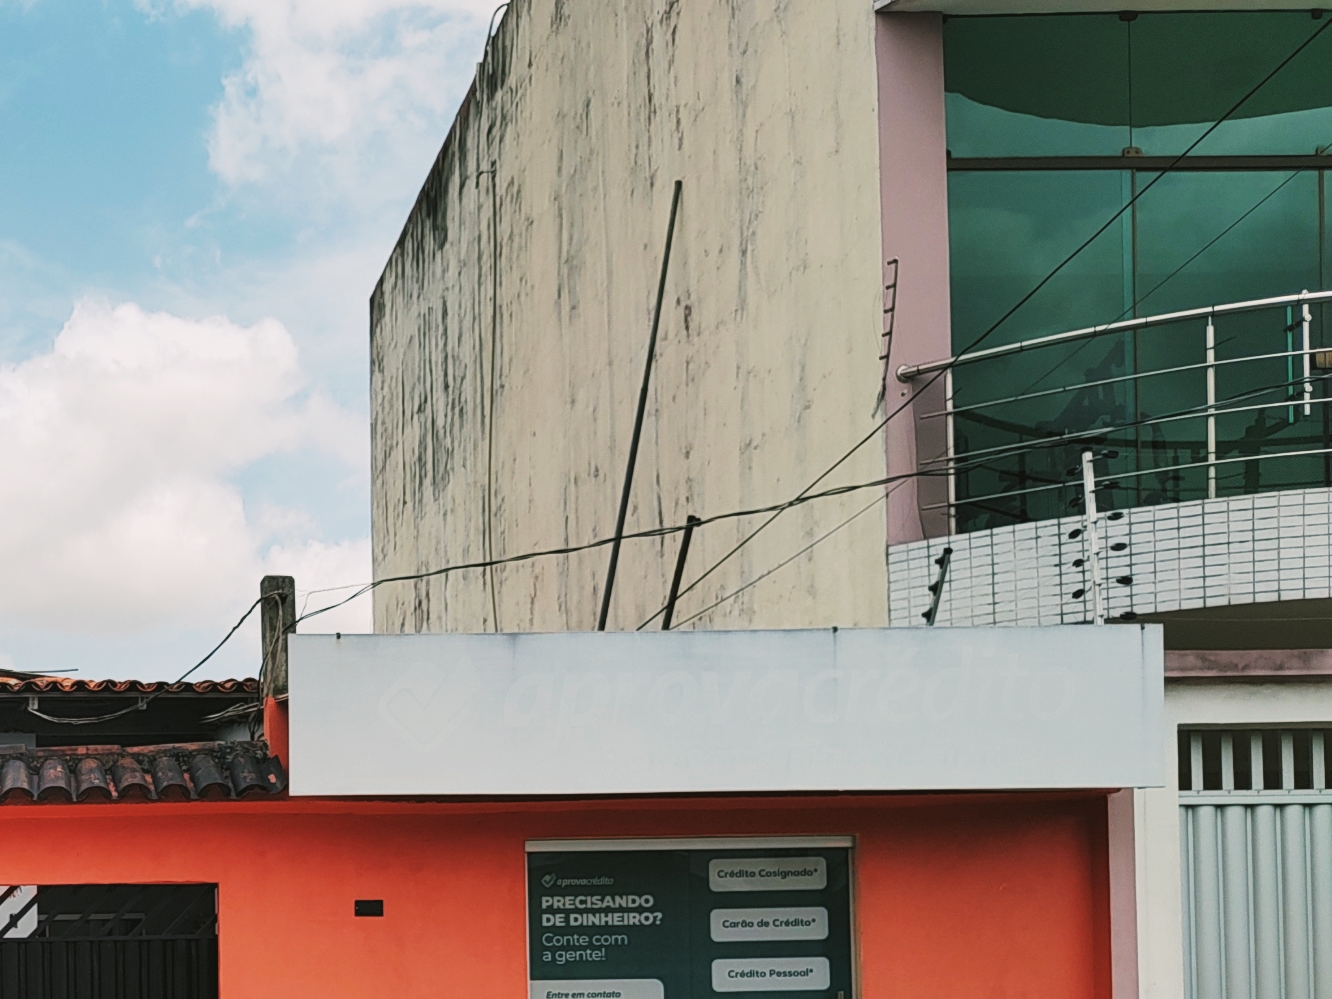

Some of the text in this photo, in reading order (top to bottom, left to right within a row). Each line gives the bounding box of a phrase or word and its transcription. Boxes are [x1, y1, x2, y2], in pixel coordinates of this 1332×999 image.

[717, 869, 756, 879] Crédito
[541, 895, 654, 909] PRECISANDO
[542, 912, 662, 926] DE DINHEIRO?
[757, 919, 770, 927] de
[542, 933, 628, 946] Conte com
[542, 948, 606, 964] a gente!
[728, 969, 767, 979] Crédito
[546, 991, 569, 999] Entre
